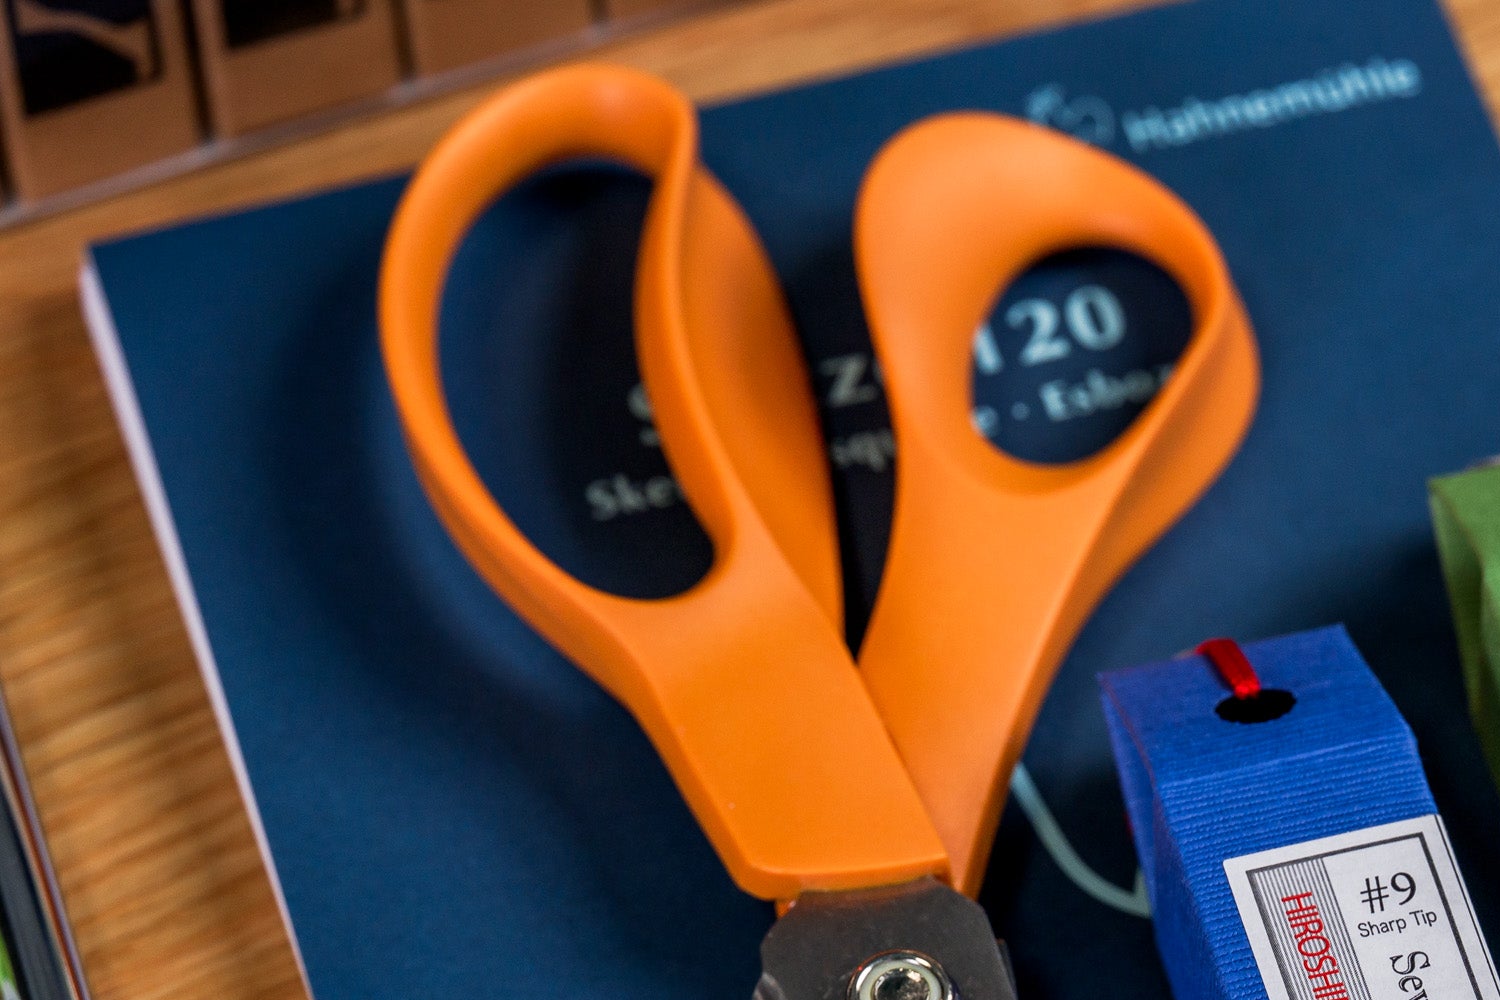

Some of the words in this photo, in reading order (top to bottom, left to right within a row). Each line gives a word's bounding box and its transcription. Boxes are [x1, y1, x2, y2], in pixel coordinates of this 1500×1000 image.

[1360, 871, 1417, 914] #9
[1357, 915, 1406, 938] Sharp
[1410, 908, 1438, 927] Tip
